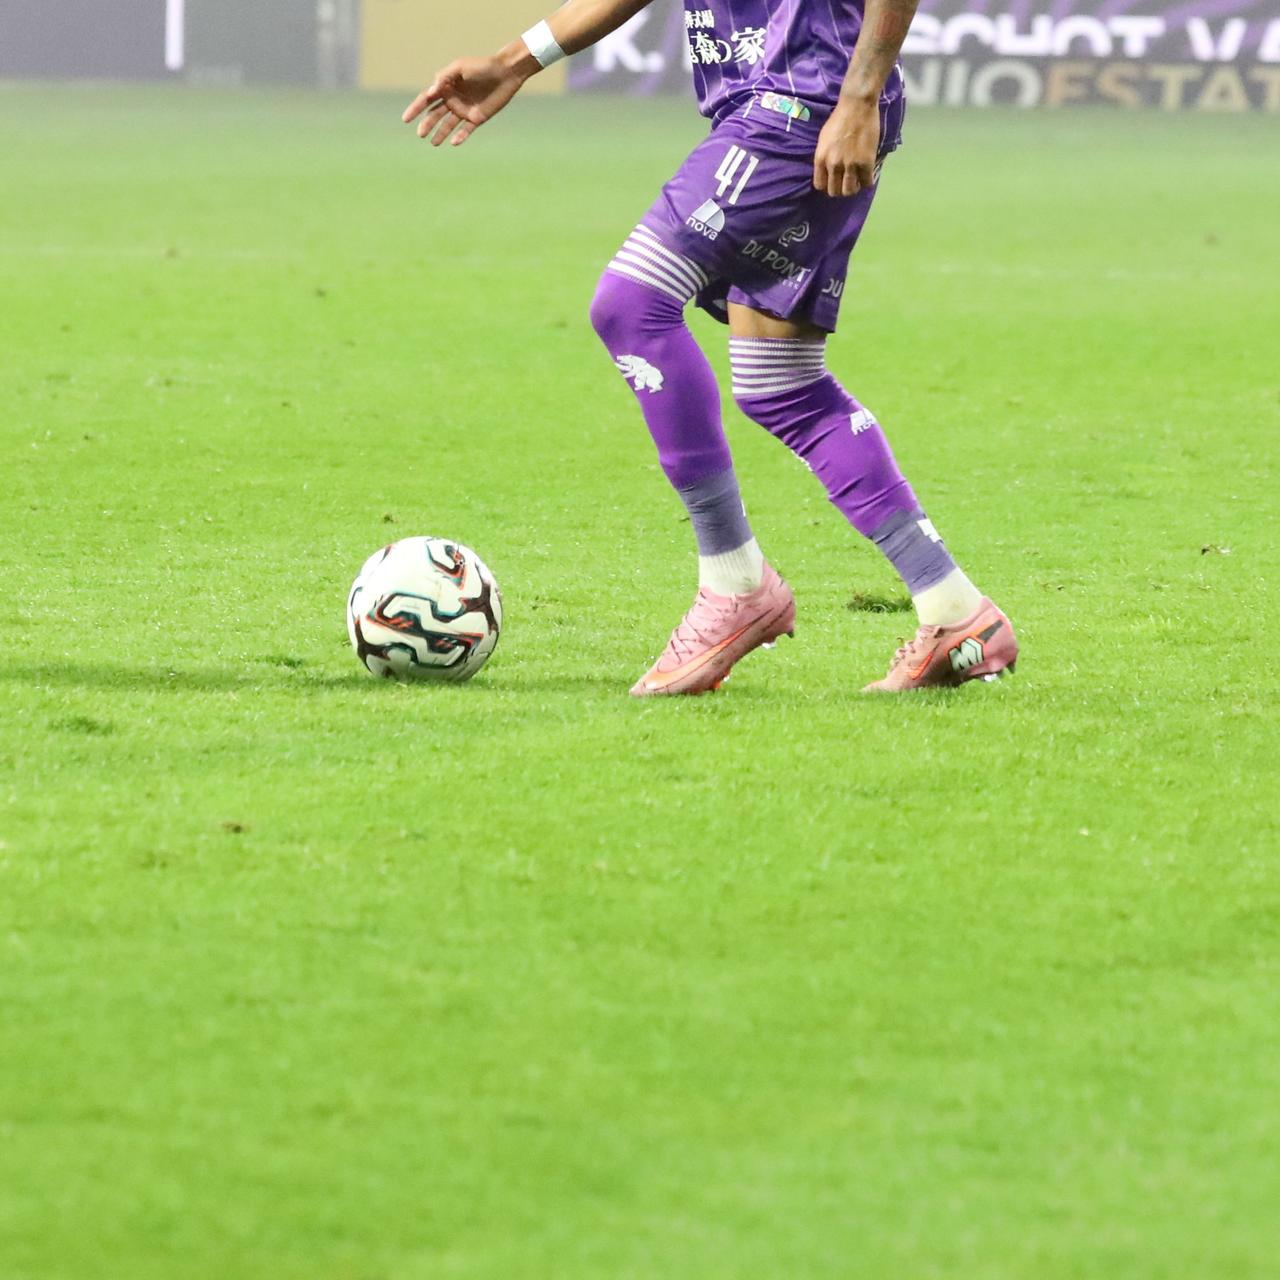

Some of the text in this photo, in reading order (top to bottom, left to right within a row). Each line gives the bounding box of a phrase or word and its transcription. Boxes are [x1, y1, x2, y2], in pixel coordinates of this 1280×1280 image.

[714, 145, 759, 205] 41
[685, 216, 718, 241] nova
[761, 249, 812, 283] PONT
